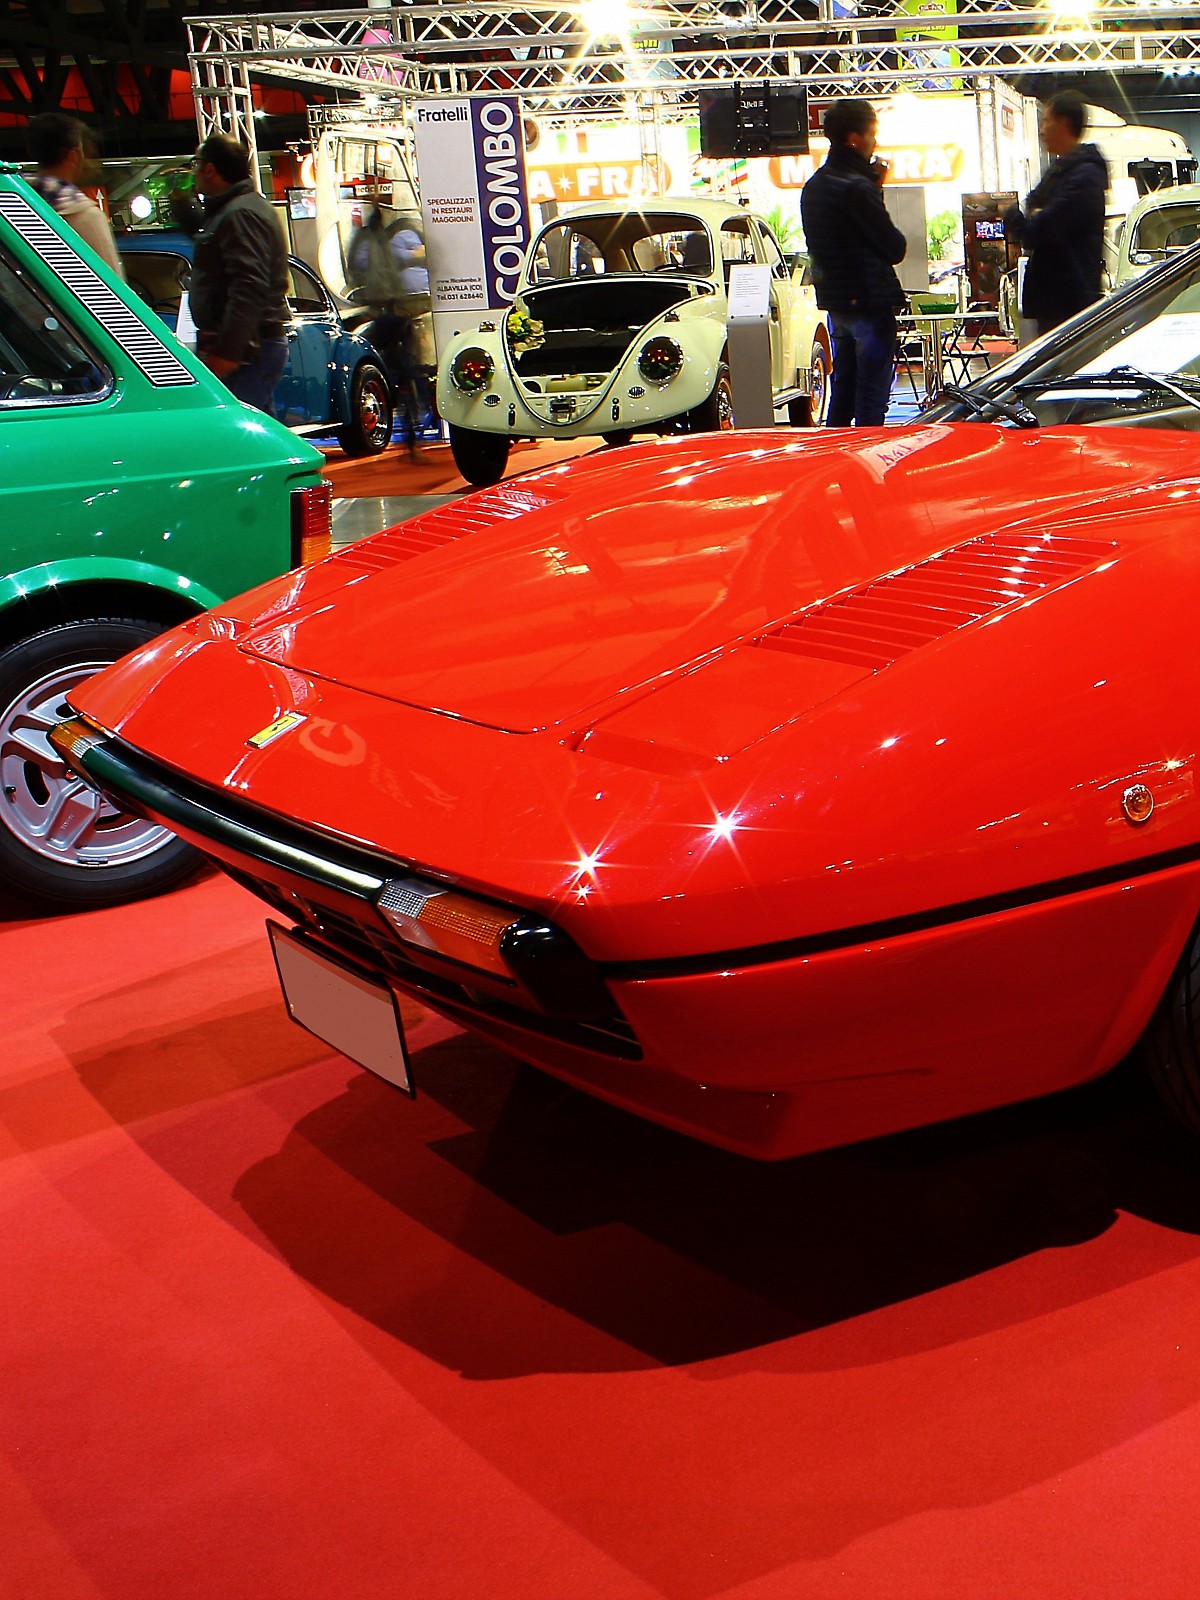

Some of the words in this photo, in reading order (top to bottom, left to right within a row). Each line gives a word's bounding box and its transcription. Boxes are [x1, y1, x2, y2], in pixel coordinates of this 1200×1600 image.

[418, 107, 468, 122] Fratelli
[427, 198, 475, 206] SPECIALIZZATI
[479, 101, 525, 302] COLOMBO
